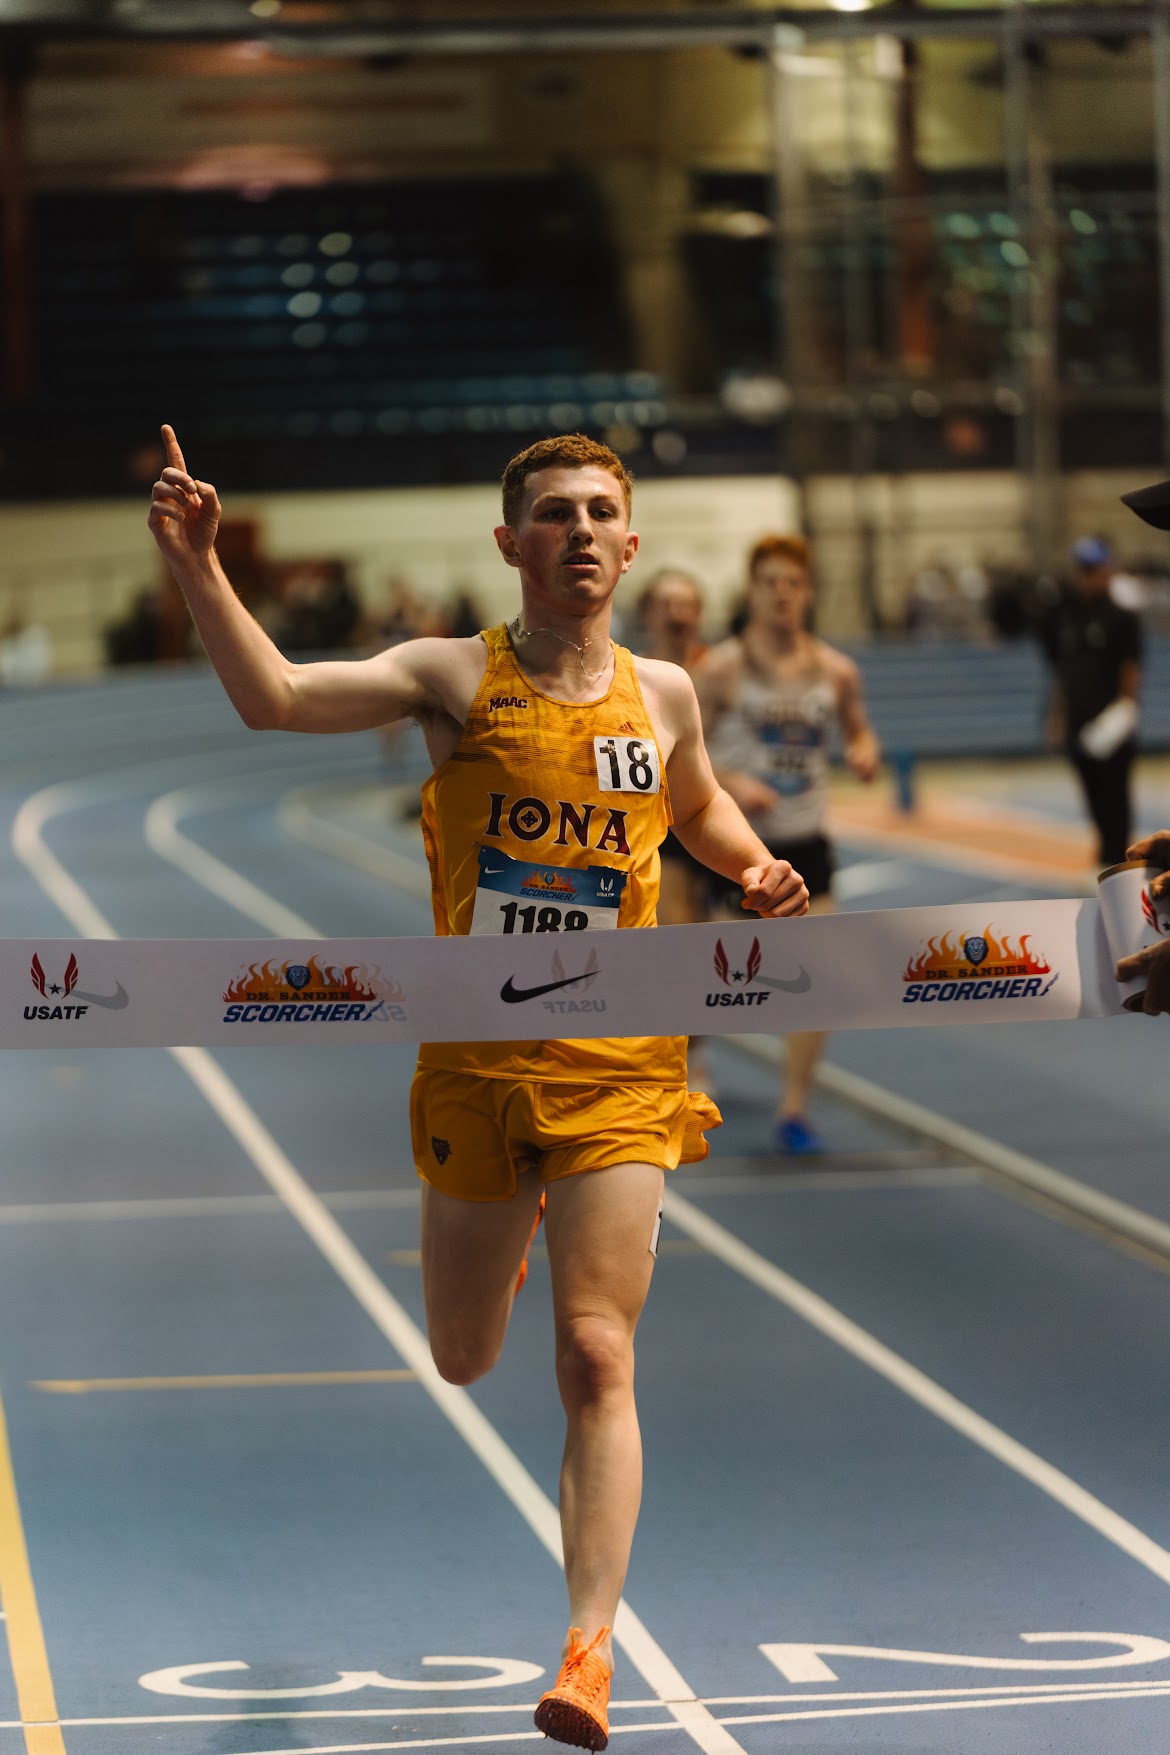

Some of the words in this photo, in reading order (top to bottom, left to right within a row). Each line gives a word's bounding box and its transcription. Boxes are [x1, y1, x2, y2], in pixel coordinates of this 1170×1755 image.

[488, 696, 528, 713] MAAC
[599, 739, 653, 790] 18
[483, 792, 632, 856] IONA
[519, 887, 574, 901] SCORCHER
[925, 969, 953, 979] DR.
[958, 965, 1028, 978] SANDER
[245, 991, 274, 1001] DR.
[279, 991, 352, 1001] SANDER
[705, 991, 770, 1007] USATF
[902, 977, 1043, 1003] SCORCHER
[23, 1005, 88, 1020] USATF
[222, 1003, 366, 1023] SCORCHER
[757, 1632, 1170, 1684] 2
[138, 1655, 546, 1699] 3
